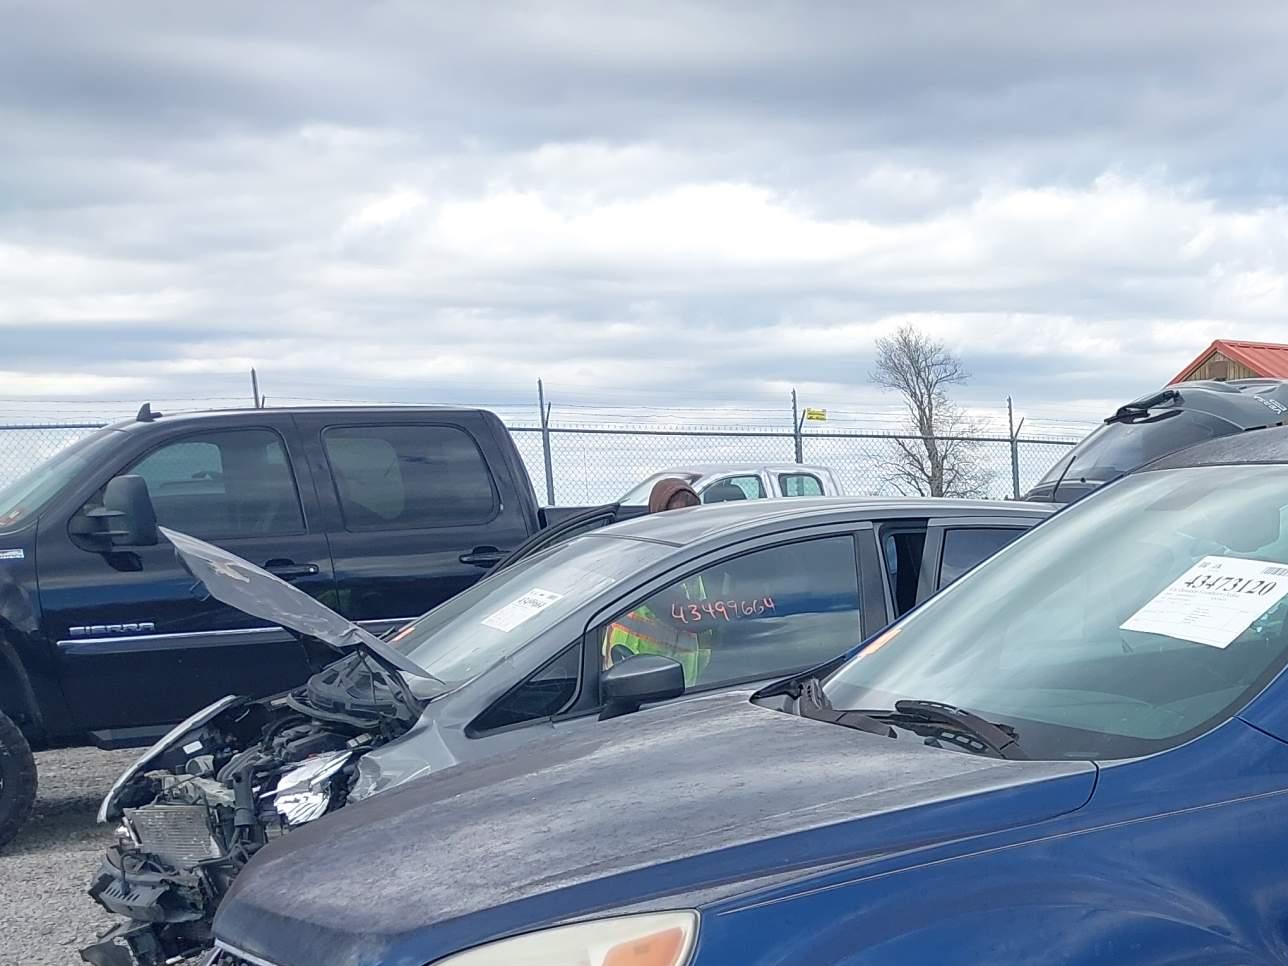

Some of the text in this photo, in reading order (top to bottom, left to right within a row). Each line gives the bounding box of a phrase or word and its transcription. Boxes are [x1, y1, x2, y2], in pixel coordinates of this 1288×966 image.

[1183, 574, 1278, 597] 43473120
[671, 597, 776, 624] 43499664
[68, 622, 156, 636] SIERRA
